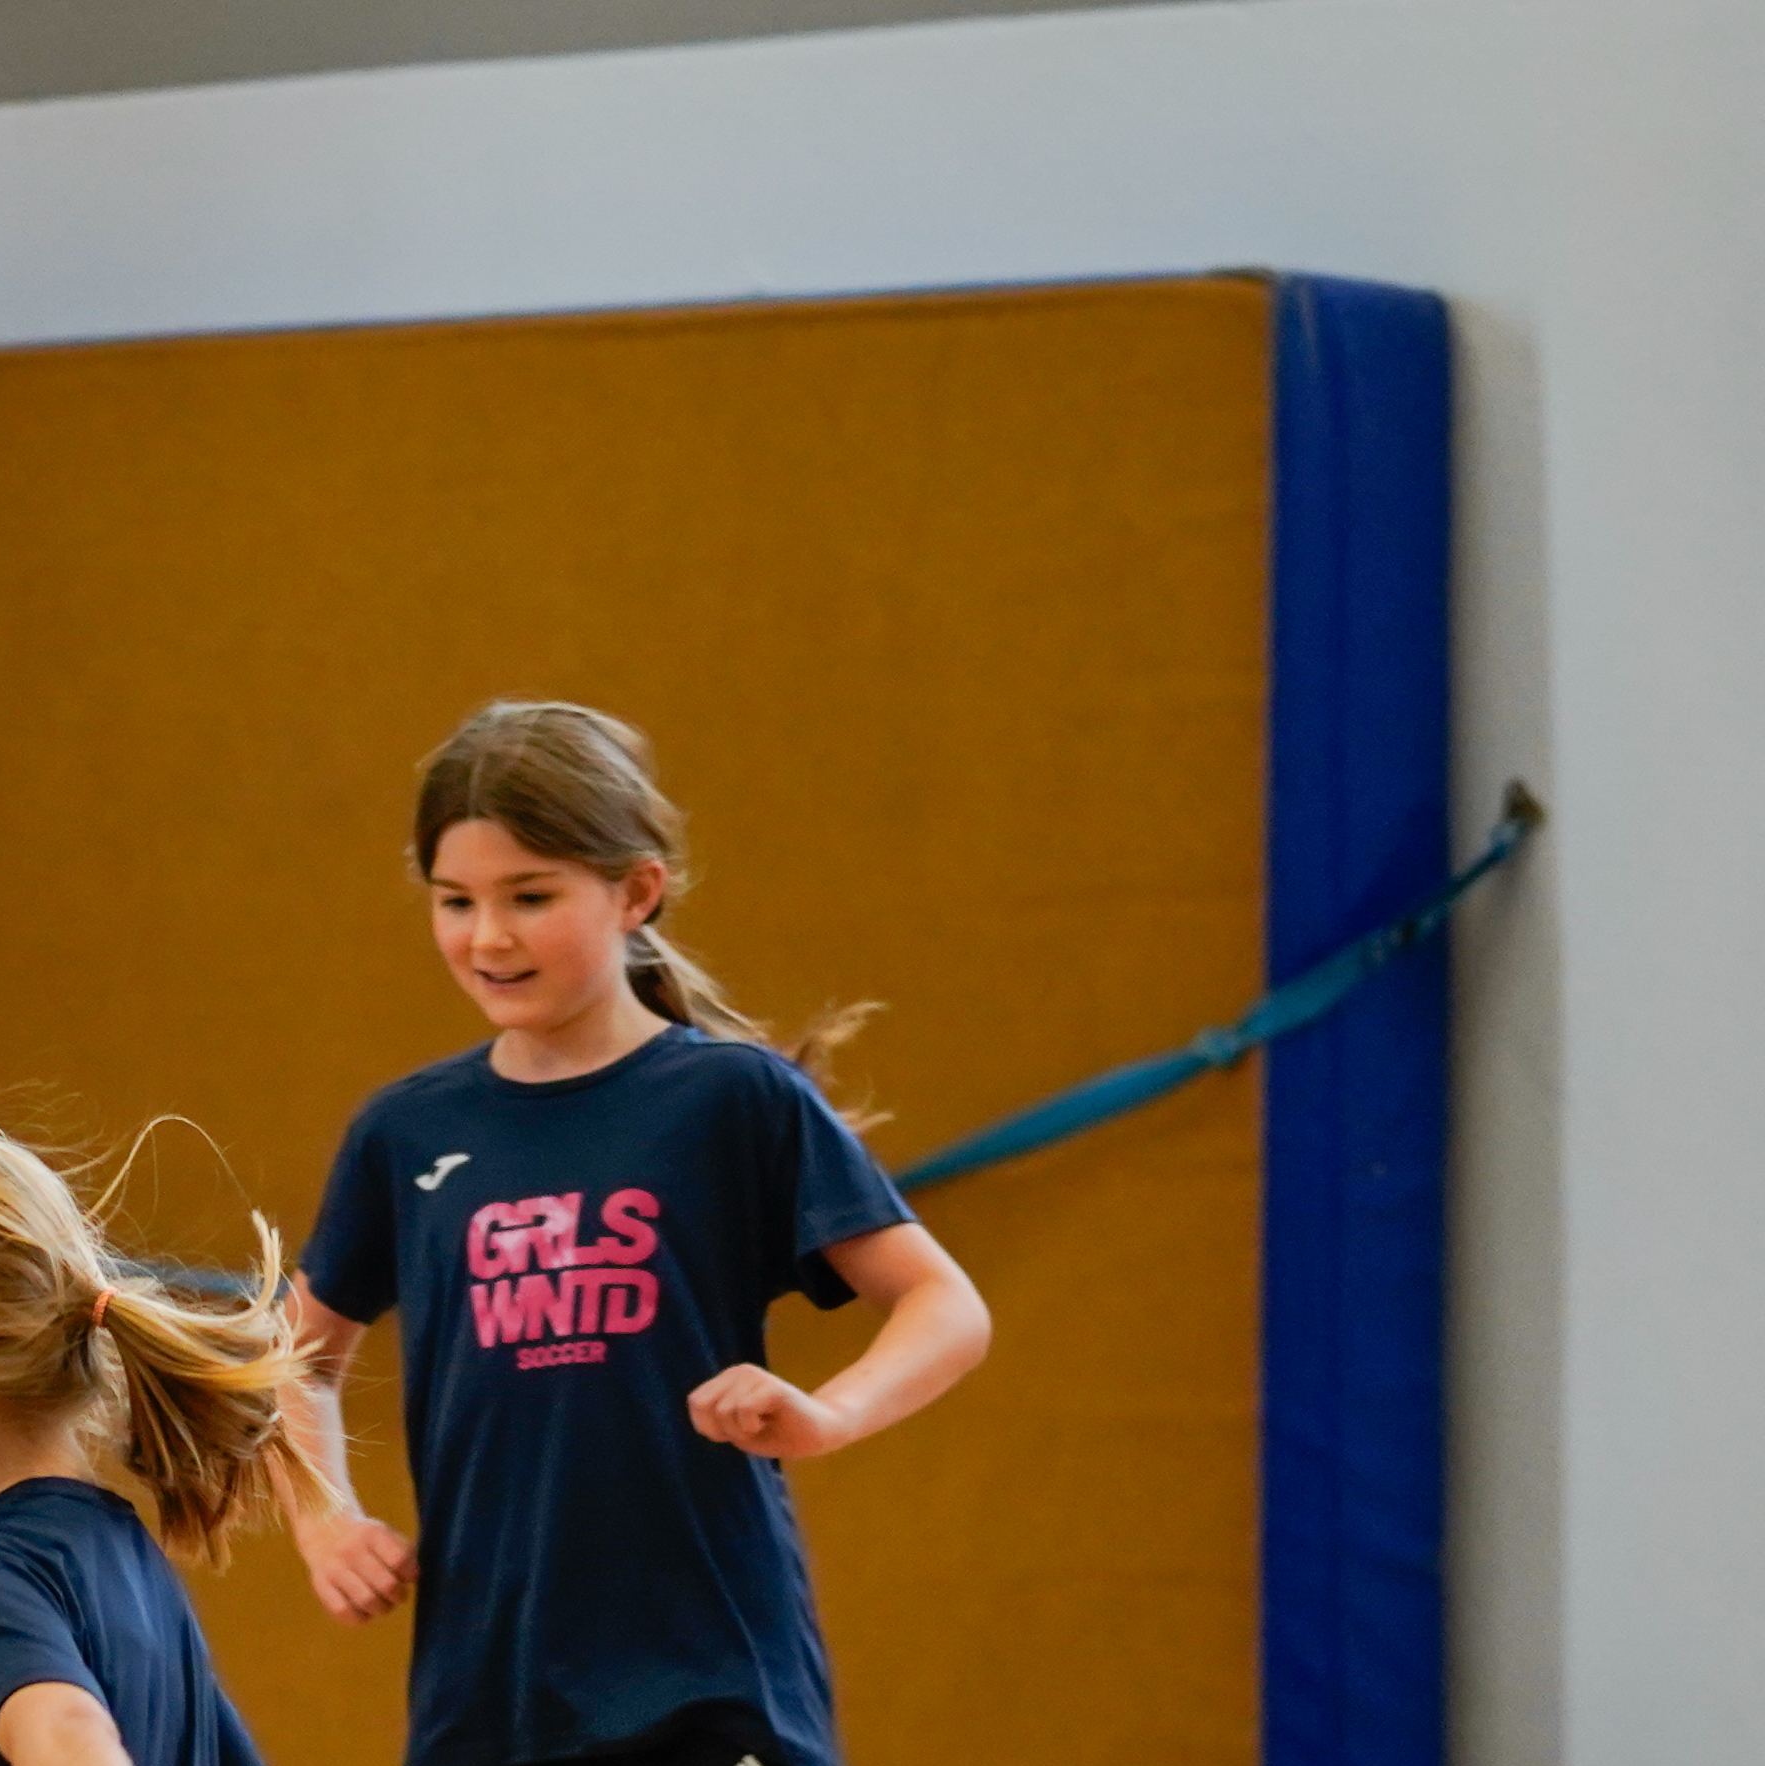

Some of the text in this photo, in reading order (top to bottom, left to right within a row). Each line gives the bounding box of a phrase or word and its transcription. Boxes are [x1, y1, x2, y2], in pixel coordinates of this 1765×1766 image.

[467, 1187, 660, 1280] GRLS
[469, 1267, 660, 1349] WNTD
[517, 1341, 607, 1371] SOCCER
